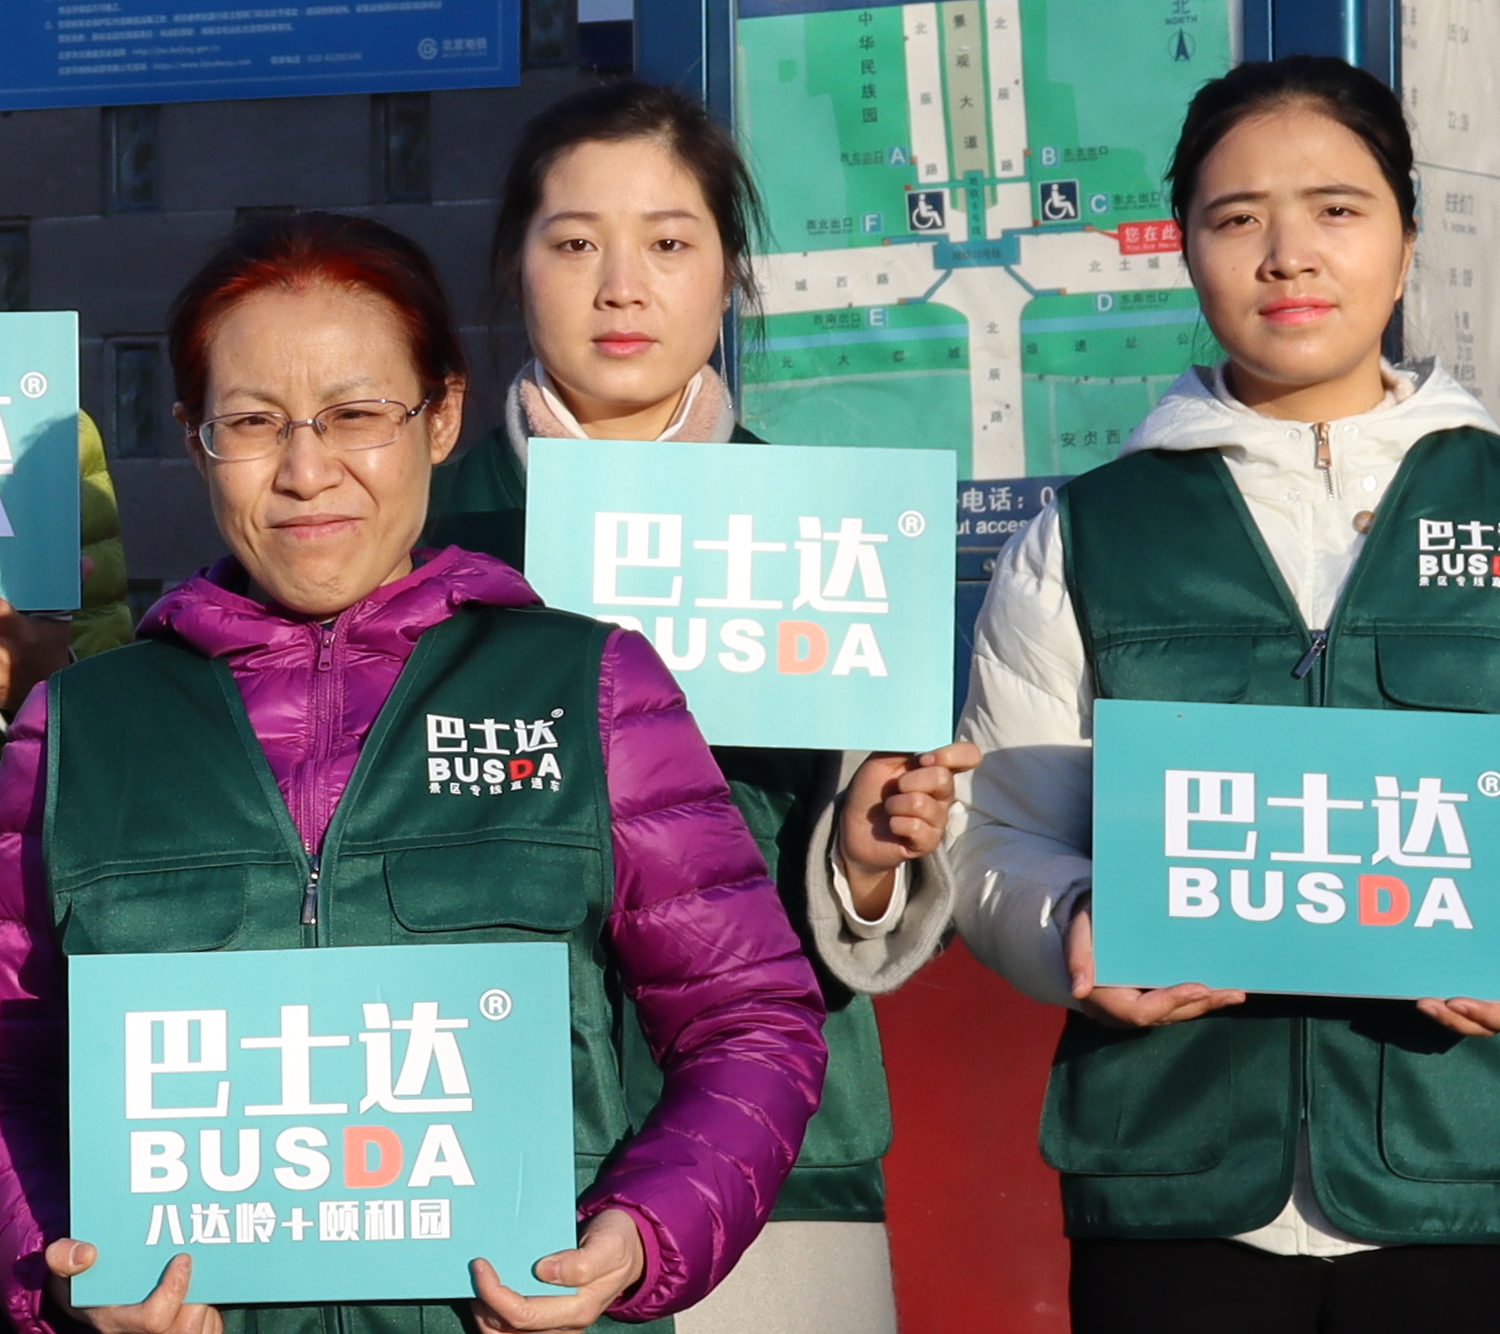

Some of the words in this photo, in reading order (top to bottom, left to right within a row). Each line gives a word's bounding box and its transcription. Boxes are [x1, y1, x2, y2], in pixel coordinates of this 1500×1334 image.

[890, 147, 906, 165] A
[1042, 146, 1056, 166] B
[1091, 194, 1107, 213] C
[865, 214, 878, 233] F
[1097, 294, 1112, 312] D
[869, 308, 884, 326] E
[596, 615, 888, 678] USDA
[427, 753, 562, 784] BUSDA
[1168, 866, 1473, 930] BUSDA
[129, 1124, 475, 1194] BUSDA
[145, 1198, 451, 1246] 八达岭+颐和园
